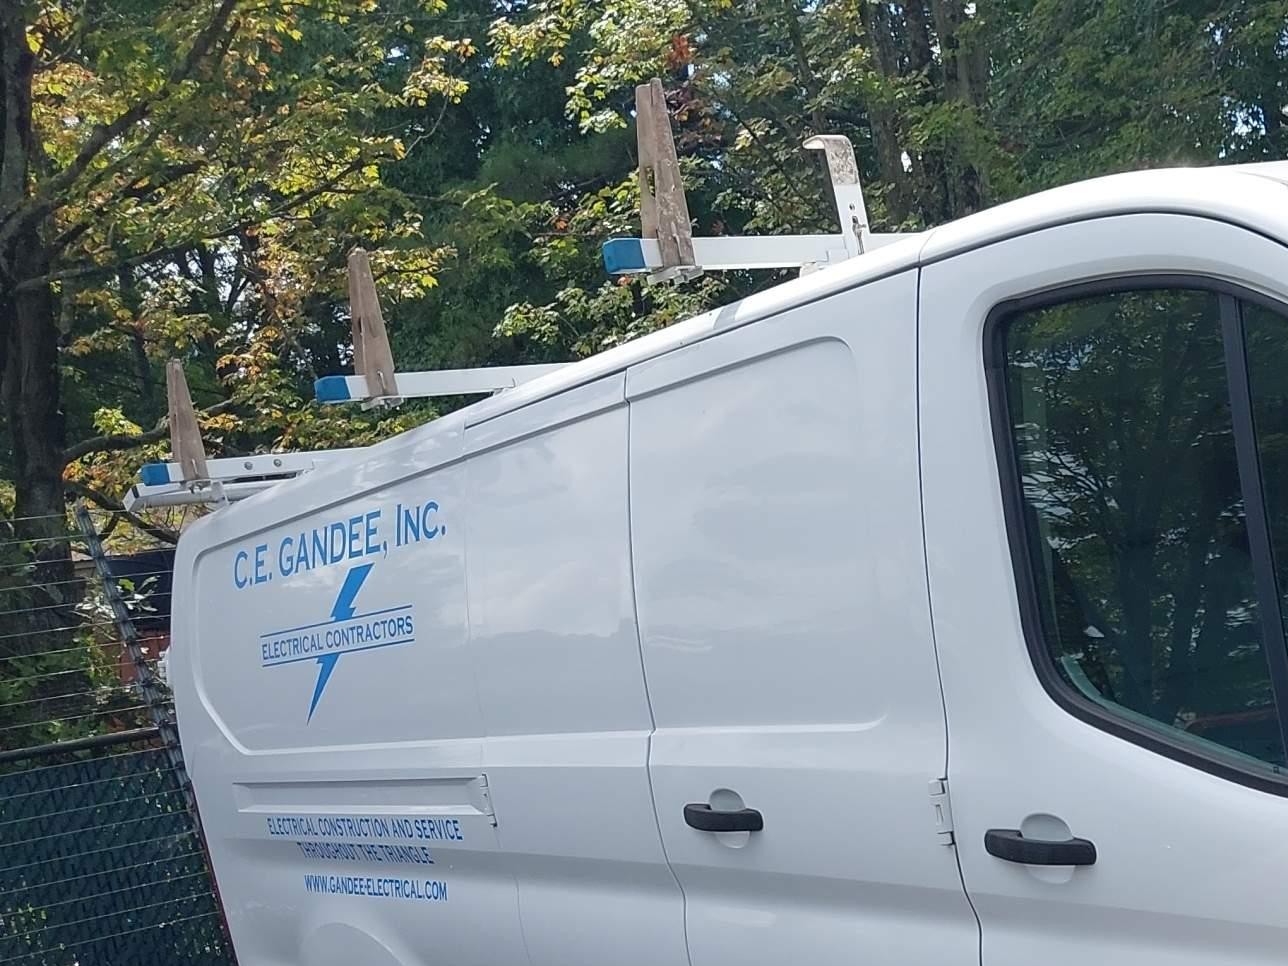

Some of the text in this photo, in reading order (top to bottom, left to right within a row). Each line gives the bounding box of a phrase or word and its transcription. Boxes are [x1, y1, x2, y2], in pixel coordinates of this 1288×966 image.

[234, 544, 272, 589] C.E.
[279, 510, 388, 577] GANDEE,
[262, 615, 414, 661] ELECTRICAL CONTRACTORS
[267, 818, 463, 841] ELECTRICAL CONSTRUCTION AND SERVICE
[297, 841, 435, 865] THROUGHOUT THE TRIANGLE
[304, 874, 448, 902] WWW.GANDEE-ELECTRICAL.COM
